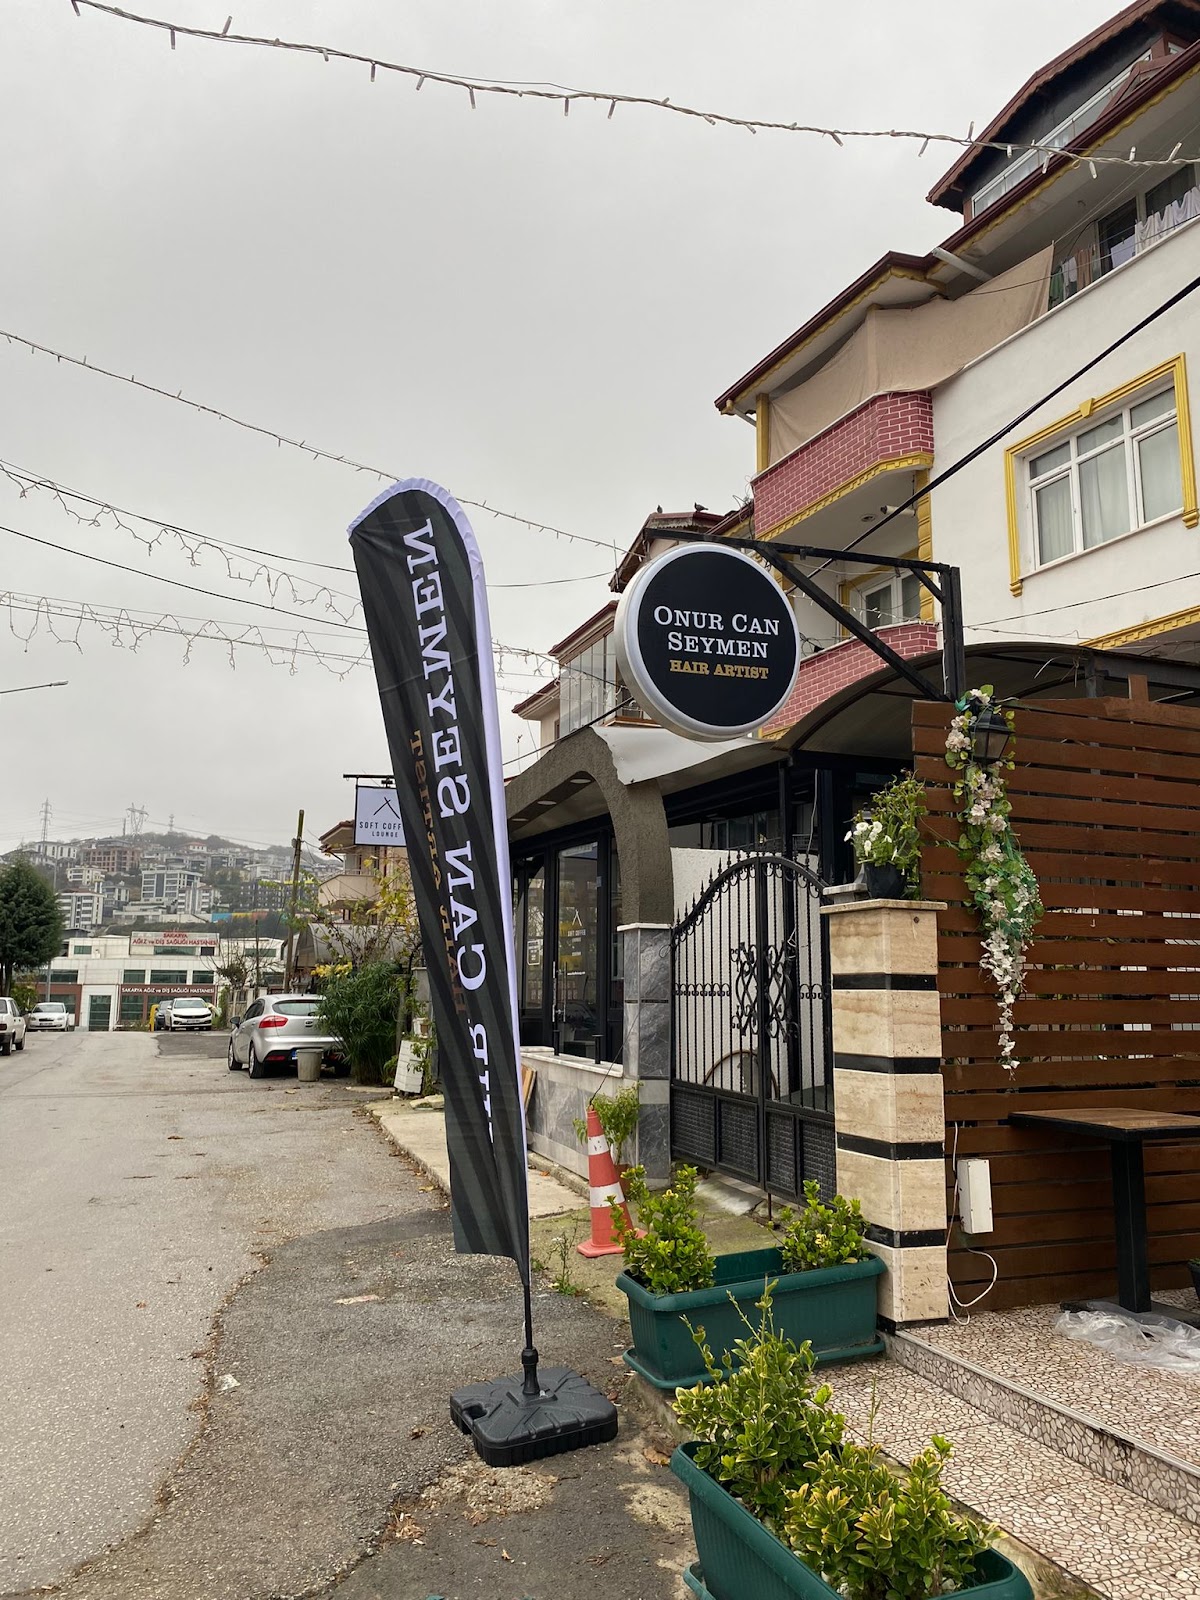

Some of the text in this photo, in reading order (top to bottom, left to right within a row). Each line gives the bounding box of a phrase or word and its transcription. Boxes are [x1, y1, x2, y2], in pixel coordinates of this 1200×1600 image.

[669, 659, 769, 680] HAIR ARTIST
[359, 821, 402, 830] SOFT COFF
